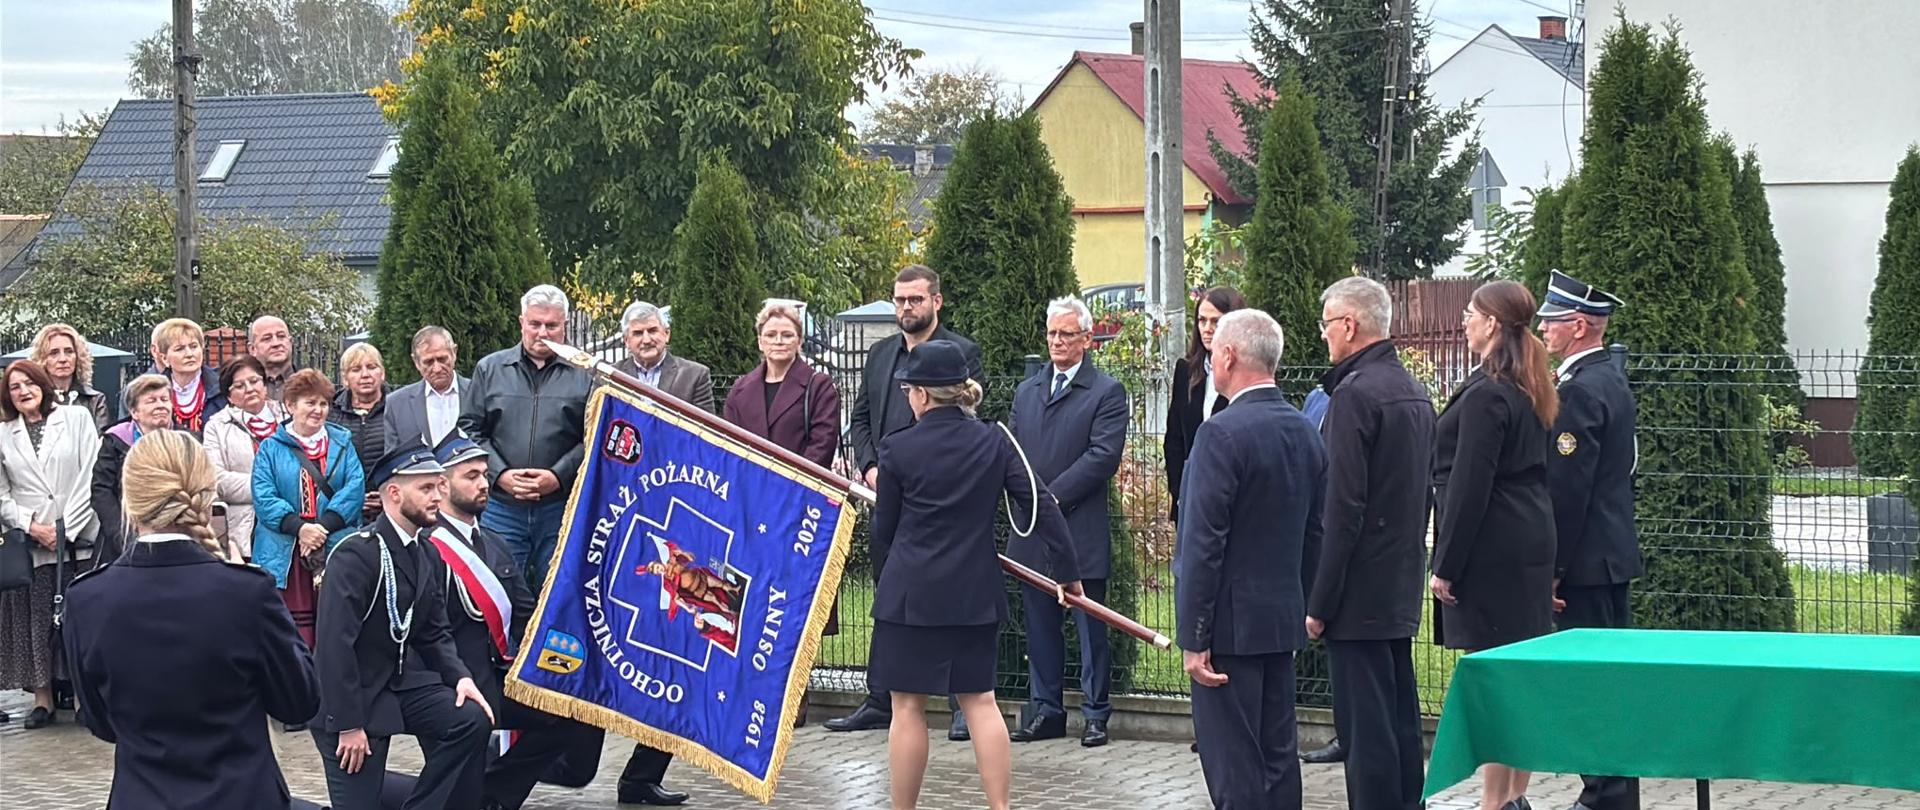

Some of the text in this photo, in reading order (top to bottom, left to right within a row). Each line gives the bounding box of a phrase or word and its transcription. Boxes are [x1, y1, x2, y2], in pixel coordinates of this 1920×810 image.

[584, 460, 730, 703] OCHOTNICZA STRAŻ POŻARNA
[745, 505, 822, 749] 1928 OSINY 2026
